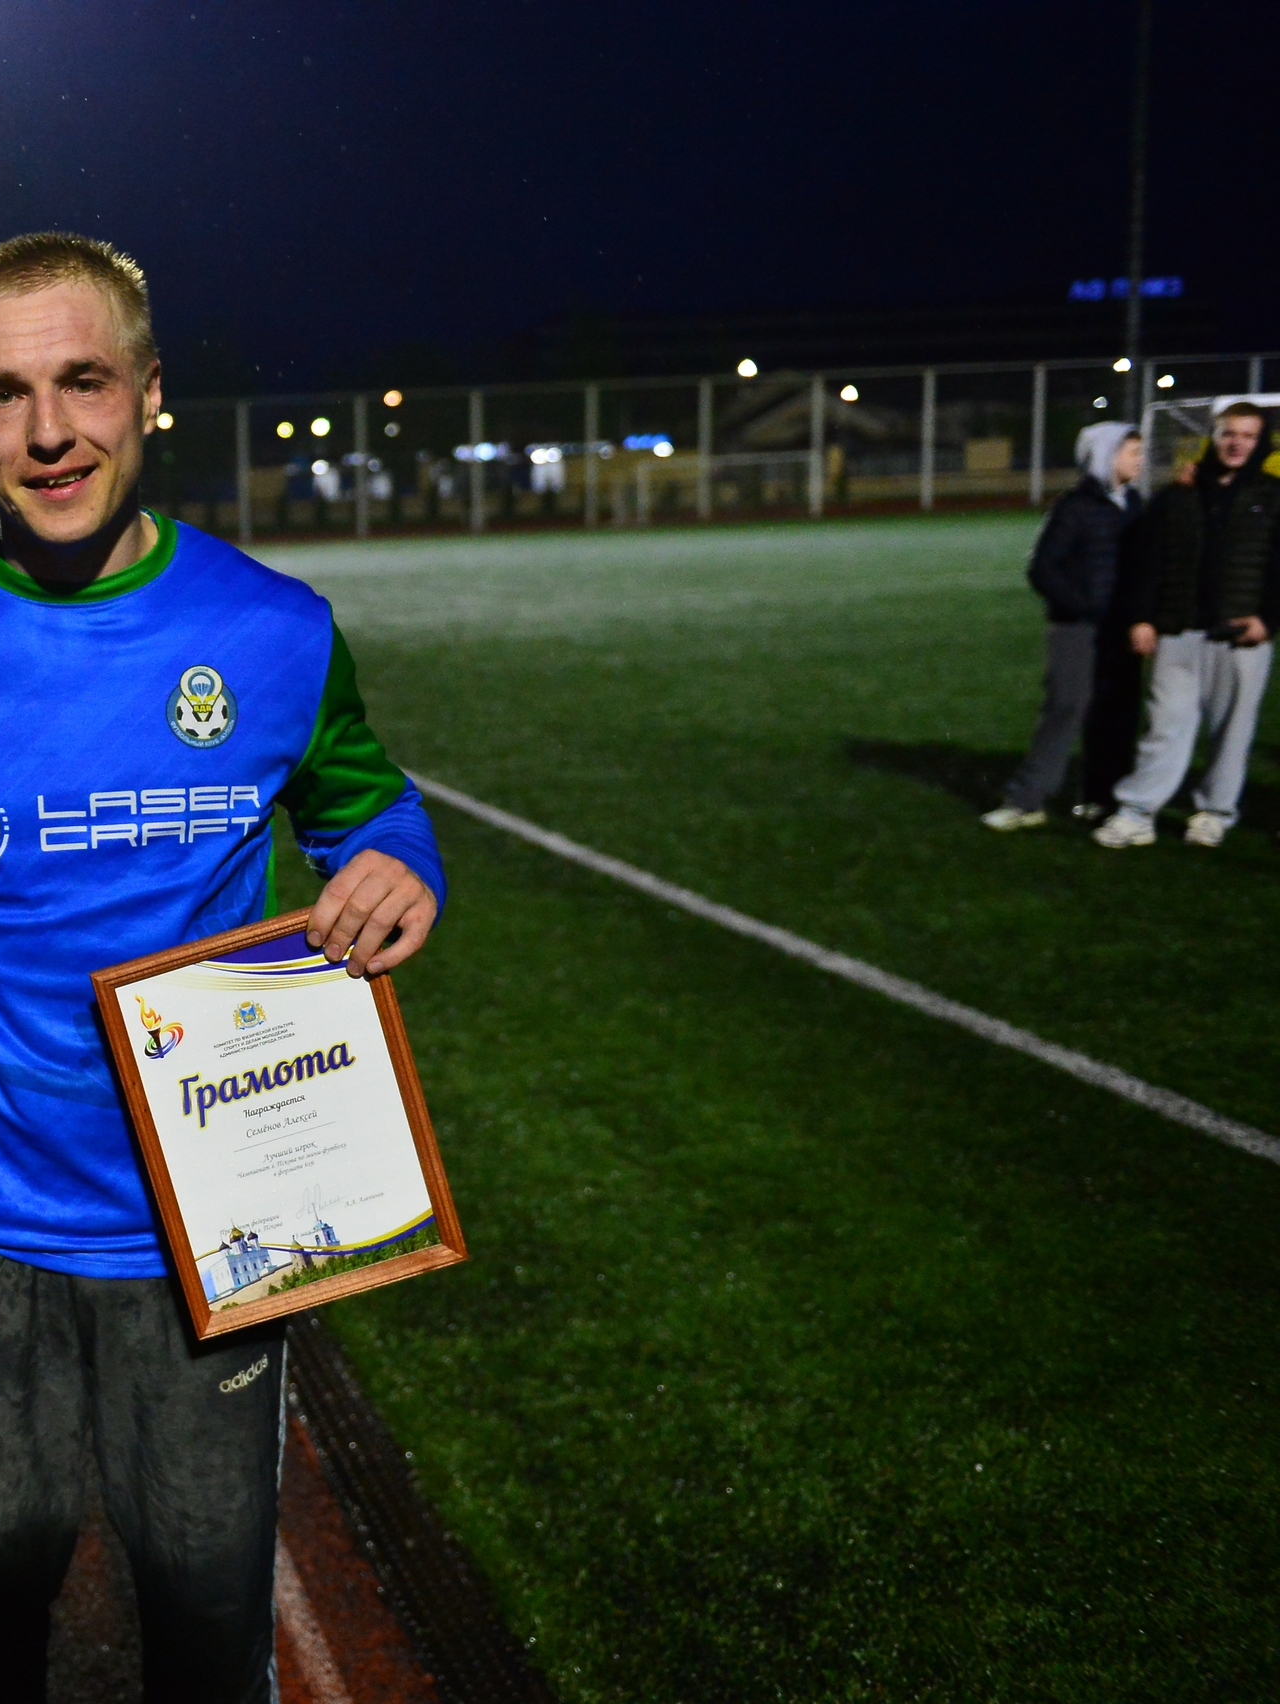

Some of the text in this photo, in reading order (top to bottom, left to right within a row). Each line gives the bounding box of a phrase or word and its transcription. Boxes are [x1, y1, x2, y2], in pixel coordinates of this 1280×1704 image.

[193, 704, 212, 713] ВДВ
[37, 785, 261, 819] LASER
[39, 816, 260, 852] CRAFT
[213, 1039, 234, 1049] КОМИТЕТ
[241, 1028, 272, 1041] ФИЗИЧЕСКОЙ
[223, 1043, 240, 1052] СПОРТУ
[245, 1037, 261, 1046] ДЕЛАМ
[259, 1037, 277, 1047] ГОРОДА
[277, 1032, 296, 1041] ПСКОВА
[179, 1040, 357, 1129] Грамота
[243, 1094, 306, 1118] Награждается
[246, 1109, 318, 1138] Семёнов Алексей
[262, 1141, 318, 1163] Лучший игрок
[219, 1353, 269, 1393] adidas
